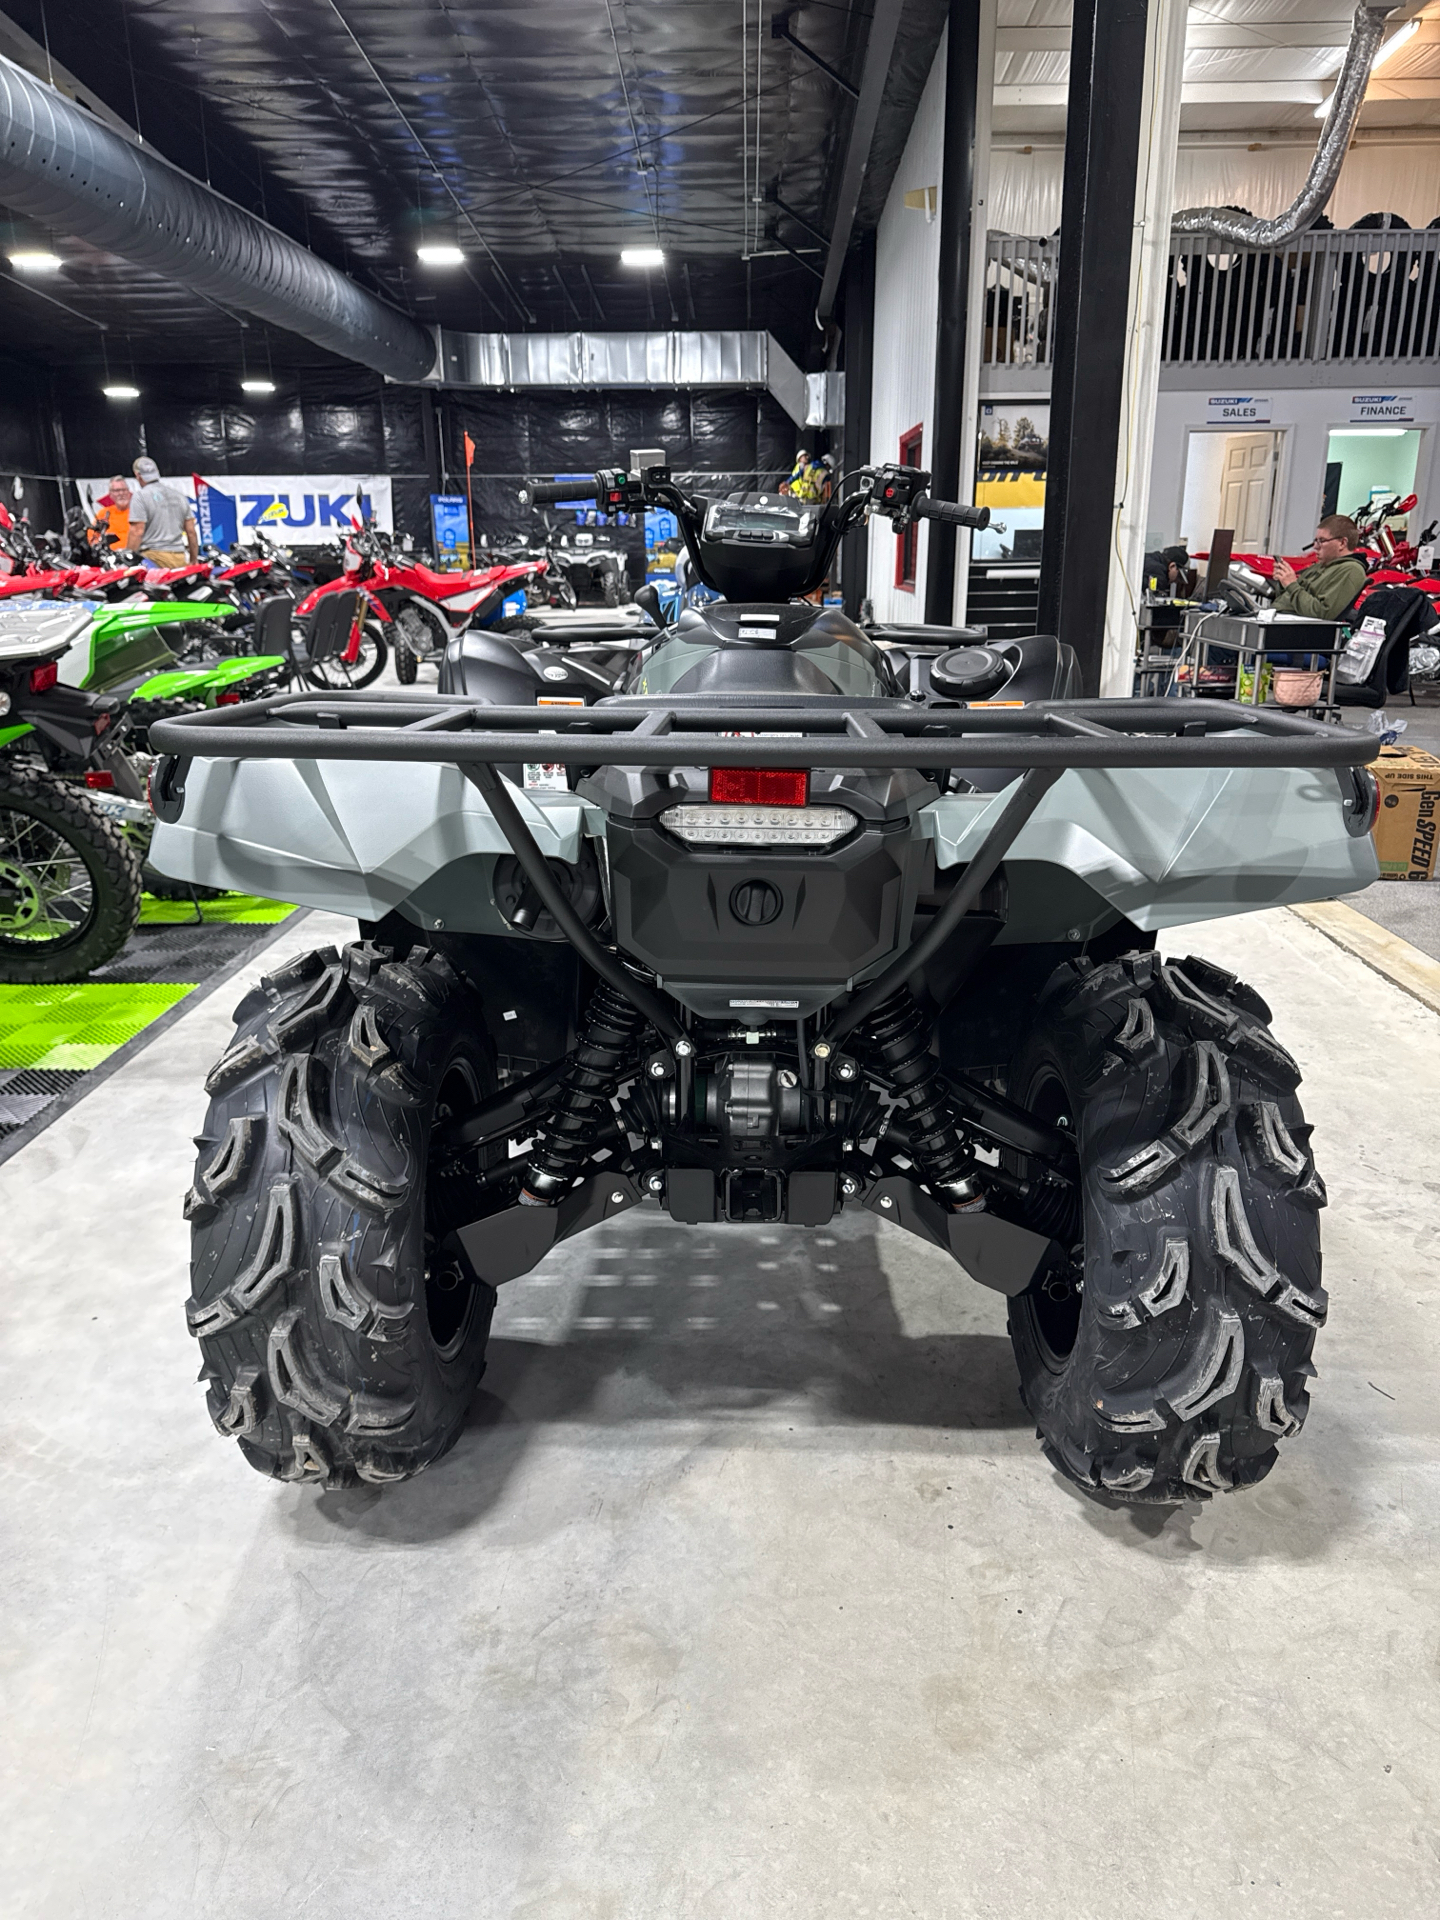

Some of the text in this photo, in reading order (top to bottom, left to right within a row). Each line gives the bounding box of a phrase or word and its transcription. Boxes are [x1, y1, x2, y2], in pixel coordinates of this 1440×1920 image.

[1222, 407, 1257, 417] SALES
[1360, 406, 1407, 416] FINANCE
[187, 494, 372, 527] ZUKI
[198, 484, 213, 543] SUZUKI
